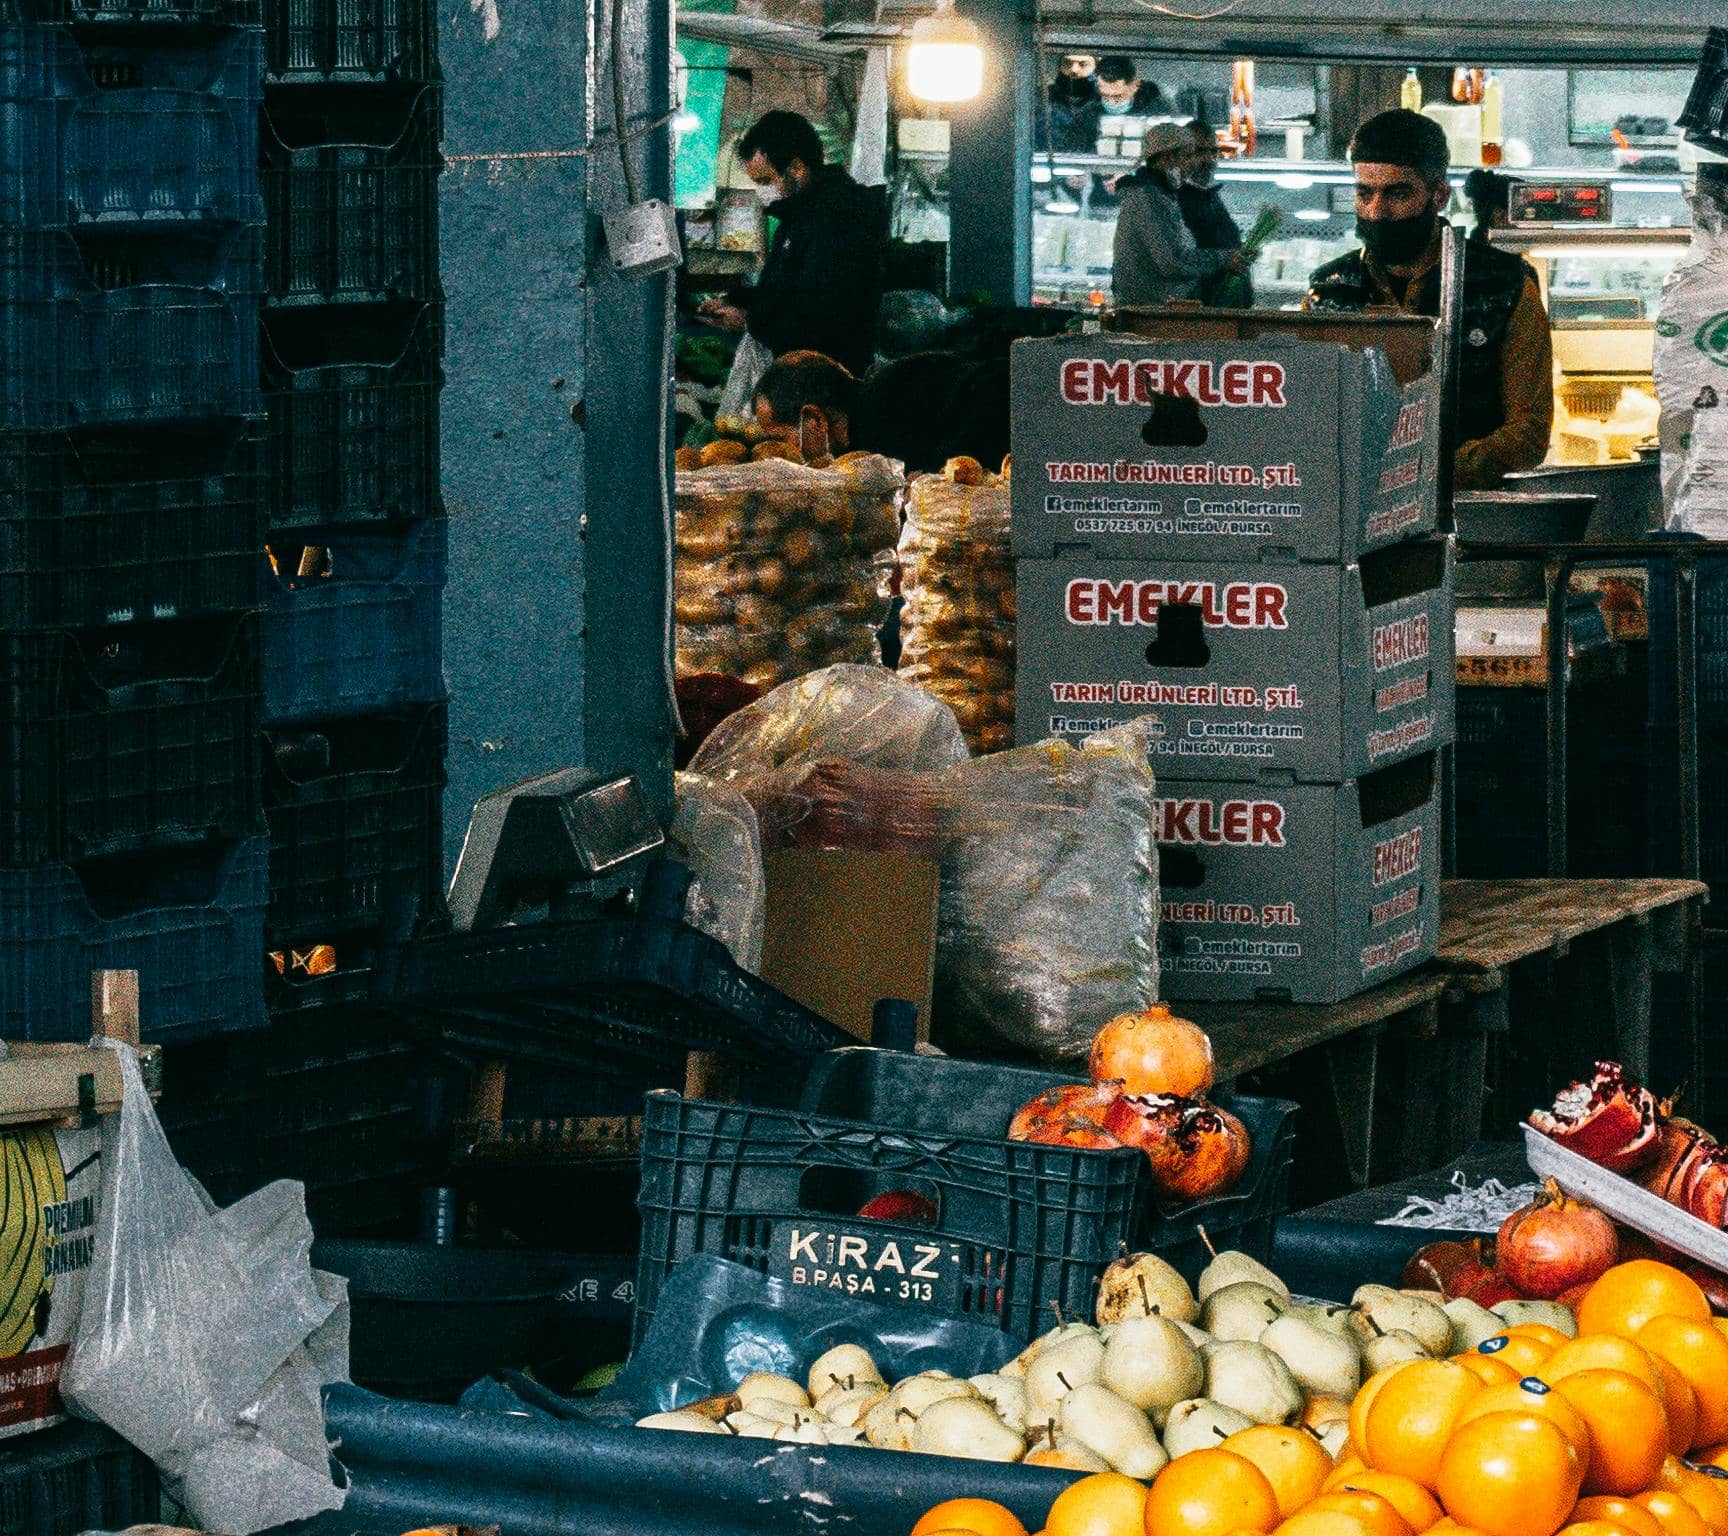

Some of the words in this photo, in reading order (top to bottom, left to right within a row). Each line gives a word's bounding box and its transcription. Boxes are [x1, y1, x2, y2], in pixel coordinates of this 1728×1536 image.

[1060, 358, 1287, 408] EMEKLER
[1046, 462, 1111, 484] TARIM
[1113, 458, 1214, 486] ÜRÜNLERİ
[1218, 464, 1260, 486] LTD.
[1262, 462, 1302, 490] ŞTİ.
[1075, 518, 1108, 532] 0537
[1109, 518, 1135, 533] 725
[1136, 519, 1154, 533] 87
[1154, 519, 1174, 533] 94
[1051, 682, 1114, 703] TARIM
[1117, 680, 1217, 706] ÜRÜNLERİ
[1221, 686, 1262, 708] LTD.
[1264, 683, 1304, 712] ŞTİ.
[1157, 740, 1175, 754] 94
[1151, 797, 1287, 848] KLER
[1217, 903, 1259, 925] LTD.
[1262, 901, 1301, 928] ŞTİ.
[898, 1280, 933, 1302] 313
